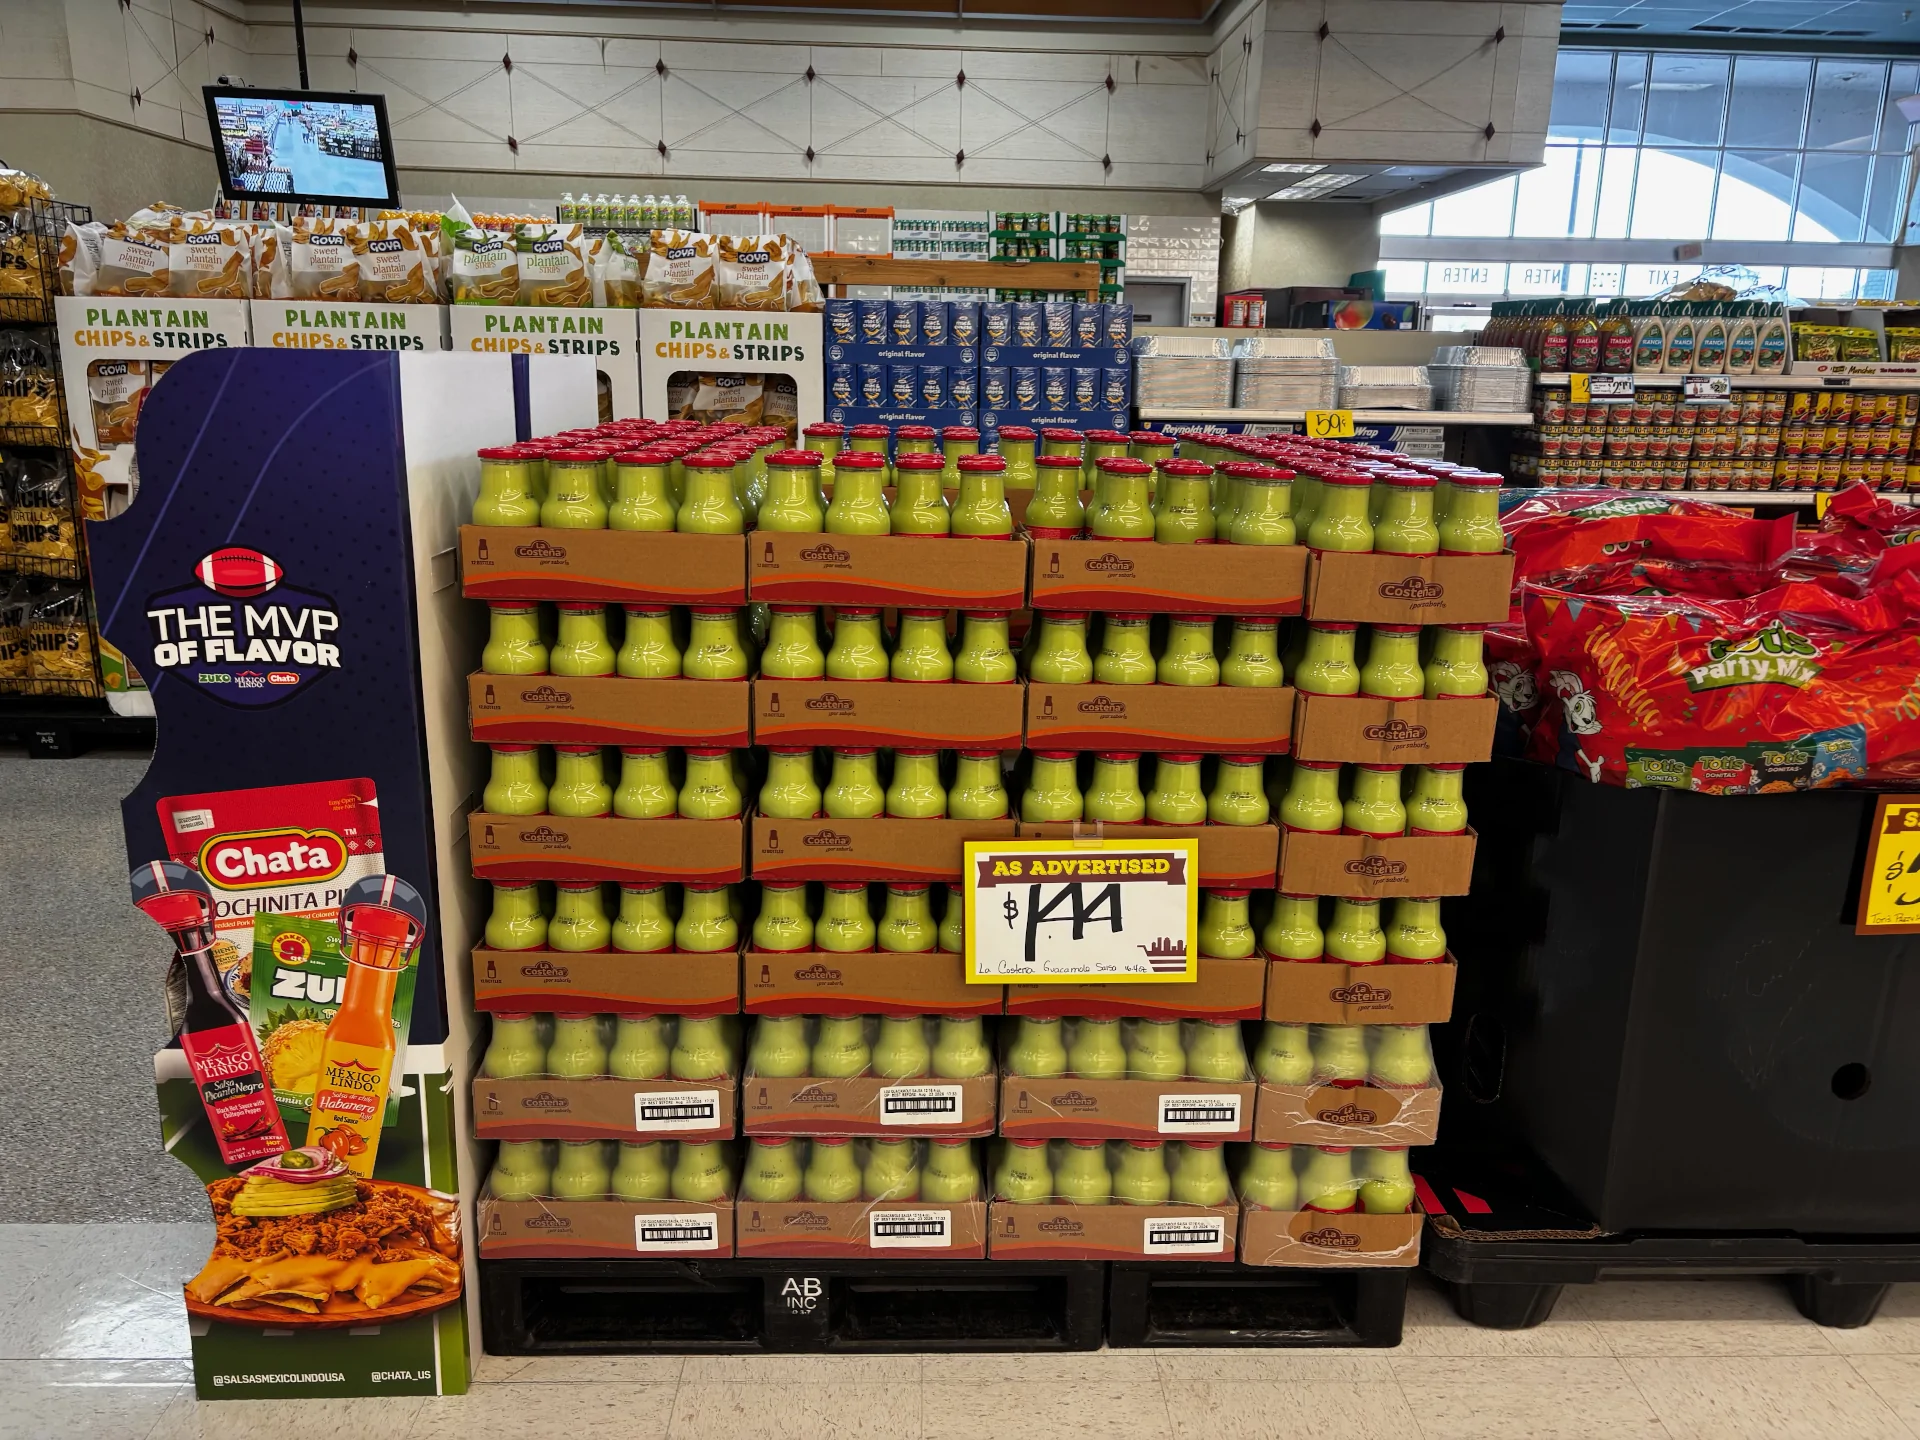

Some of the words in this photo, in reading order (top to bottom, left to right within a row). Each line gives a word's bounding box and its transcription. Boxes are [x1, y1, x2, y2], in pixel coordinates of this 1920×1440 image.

[187, 234, 221, 244] GOYA
[310, 236, 344, 245] GOYA
[126, 245, 154, 259] sweet
[190, 246, 218, 255] sweet
[370, 241, 402, 251] GOYA
[473, 242, 502, 252] GOYA
[533, 242, 563, 252] GOYA
[186, 253, 223, 265] plantain
[376, 255, 400, 263] sweet
[463, 251, 507, 266] plantain
[668, 249, 695, 258] GOYA
[738, 253, 769, 263] GOYA
[118, 252, 155, 268] plantain
[310, 255, 343, 266] plantain
[526, 253, 570, 269] plantain
[669, 260, 691, 269] sweet
[372, 263, 406, 275] plantain
[663, 268, 695, 278] plantain
[736, 272, 769, 281] plantain
[86, 308, 209, 328] PLANTAIN
[285, 309, 406, 330] PLANTAIN
[485, 315, 603, 334] PLANTAIN
[670, 321, 789, 341] PLANTAIN
[74, 330, 137, 347] CHIPS
[152, 331, 228, 349] STRIPS
[272, 332, 335, 349] CHIPS
[350, 334, 424, 351] STRIPS
[471, 337, 532, 354] CHIPS
[548, 339, 620, 356] STRIPS
[655, 342, 717, 359] CHIPS
[733, 344, 805, 362] STRIPS
[878, 350, 904, 358] original
[905, 350, 926, 358] flavor
[1033, 352, 1059, 360] original
[1060, 352, 1081, 360] flavor
[99, 364, 127, 375] GOYA
[717, 378, 745, 387] GOYA
[713, 396, 746, 406] plantain
[1031, 417, 1057, 425] original
[1057, 417, 1078, 425] flavor
[1162, 423, 1203, 435] Reynolds
[1203, 424, 1228, 436] Wrap
[147, 605, 235, 641] THE
[244, 605, 339, 641] MVP
[30, 633, 79, 651] CHIPS
[154, 640, 198, 668] OF
[204, 638, 342, 668] FLAVOR
[1690, 657, 1771, 684] Party
[1776, 658, 1816, 681] Mix
[199, 673, 231, 683] ZUKO
[270, 674, 296, 683] Chata
[238, 681, 264, 689] LINDO
[1699, 755, 1745, 771] Totis
[1762, 750, 1808, 766] Totis
[1640, 757, 1686, 773] Totis
[215, 841, 332, 878] Chata
[992, 860, 1023, 876] AS
[1029, 858, 1171, 876] ADVERTISED
[216, 891, 318, 917] OCHINITA
[312, 911, 335, 920] Colored
[236, 919, 251, 928] Pork
[276, 934, 306, 944] MAKES
[279, 940, 305, 961] 9
[978, 962, 992, 974] La
[272, 968, 346, 1004] ZU
[205, 1061, 249, 1078] LINDO
[214, 1080, 236, 1091] Salsa
[330, 1077, 373, 1092] LINDO
[205, 1086, 235, 1102] Picante
[235, 1082, 264, 1094] Negra
[305, 1097, 313, 1106] C
[320, 1096, 376, 1113] Habanero
[216, 1106, 230, 1115] Black
[239, 1103, 253, 1111] Sauce
[244, 1107, 261, 1115] Pepper
[343, 1116, 359, 1124] Sauce
[1323, 1112, 1370, 1122] Costeña
[787, 1297, 817, 1309] INC
[213, 1373, 346, 1387] @SALSASMEXICOLINDOUSA
[371, 1370, 432, 1383] @CHATA_US
